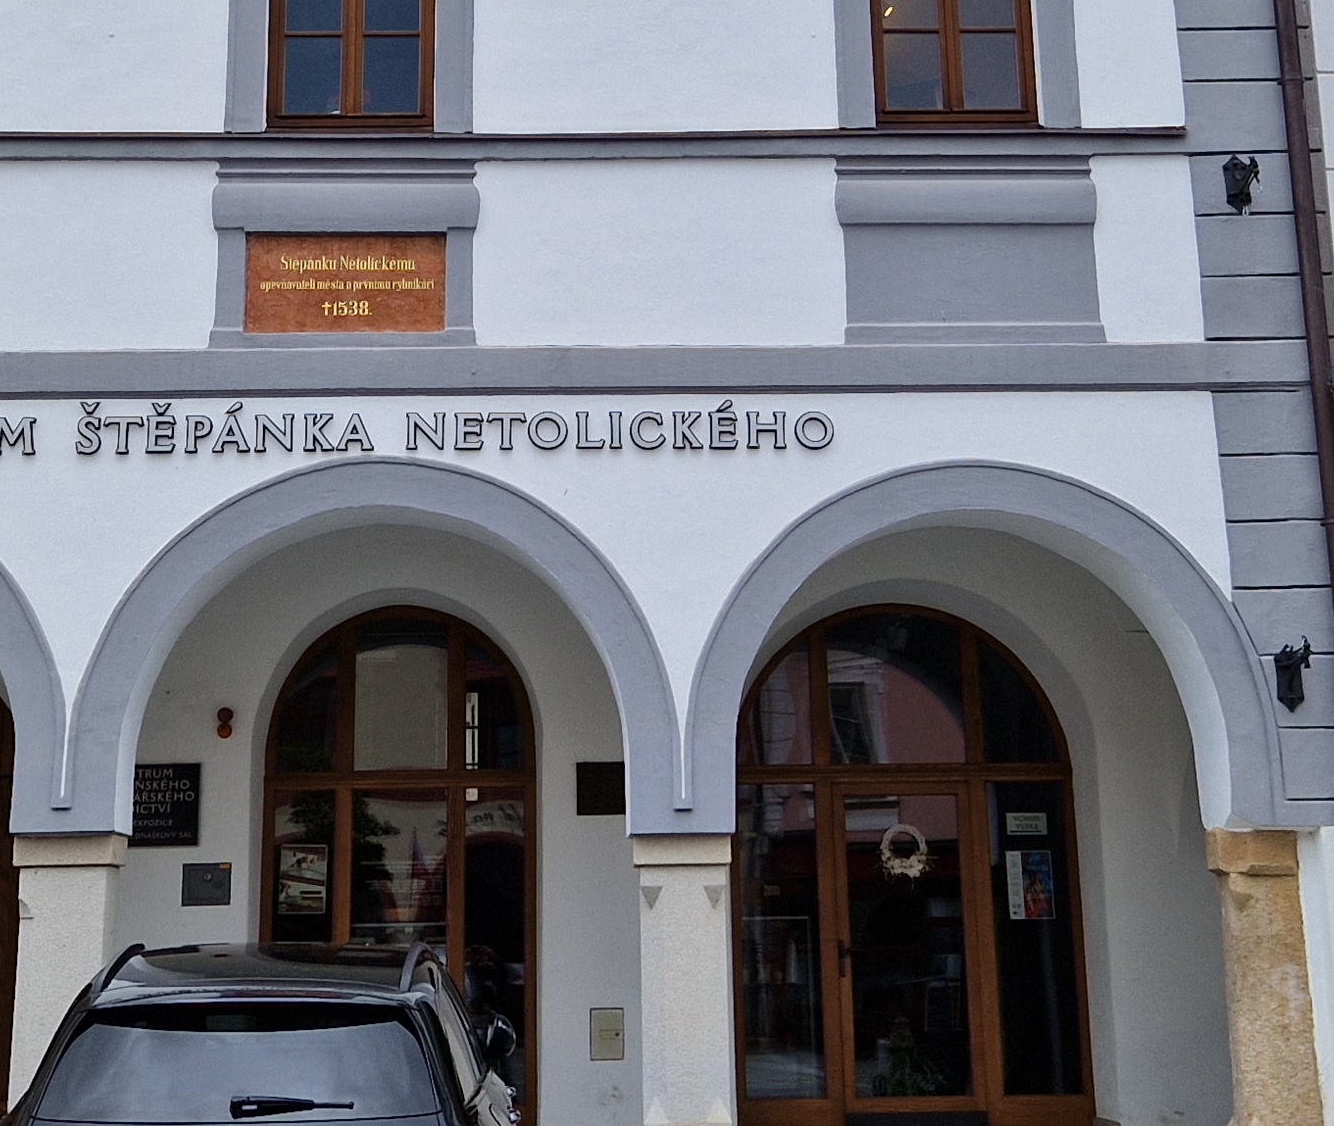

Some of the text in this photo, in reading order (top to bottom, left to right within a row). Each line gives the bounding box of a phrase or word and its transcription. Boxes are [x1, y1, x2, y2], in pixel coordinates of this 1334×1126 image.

[75, 401, 375, 455] ŠTĚPÁNKA
[405, 399, 835, 451] NETOLICKÉHO
[137, 768, 173, 779] TRUM
[135, 779, 190, 791] ŇSKÉHO
[133, 790, 195, 803] ÁŘSKÉHO
[136, 801, 171, 814] ICTVÍ
